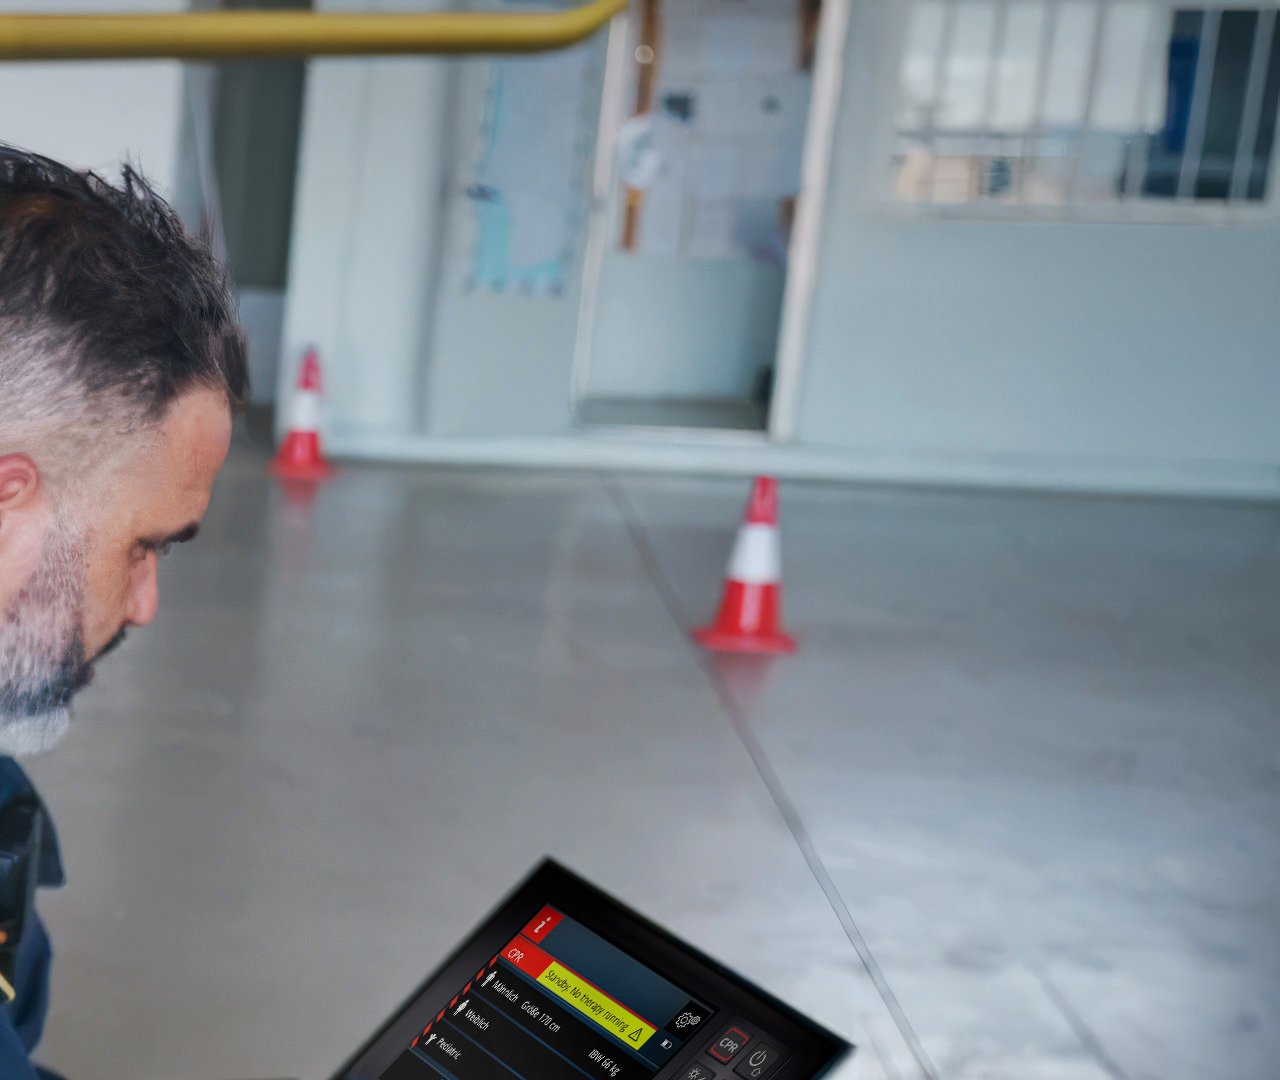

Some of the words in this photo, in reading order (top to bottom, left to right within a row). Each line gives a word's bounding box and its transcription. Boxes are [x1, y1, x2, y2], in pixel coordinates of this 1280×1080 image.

[507, 948, 525, 963] CPR
[465, 1009, 490, 1031] Weiblich
[570, 987, 581, 999] No
[580, 994, 605, 1016] therapy
[602, 1009, 630, 1033] running
[492, 980, 519, 1003] Männlich
[539, 1013, 552, 1027] 170
[548, 1022, 561, 1033] cm
[601, 1058, 614, 1070] 66
[610, 1063, 621, 1078] kg
[436, 1037, 462, 1060] Pediatric
[720, 1037, 739, 1053] CPR
